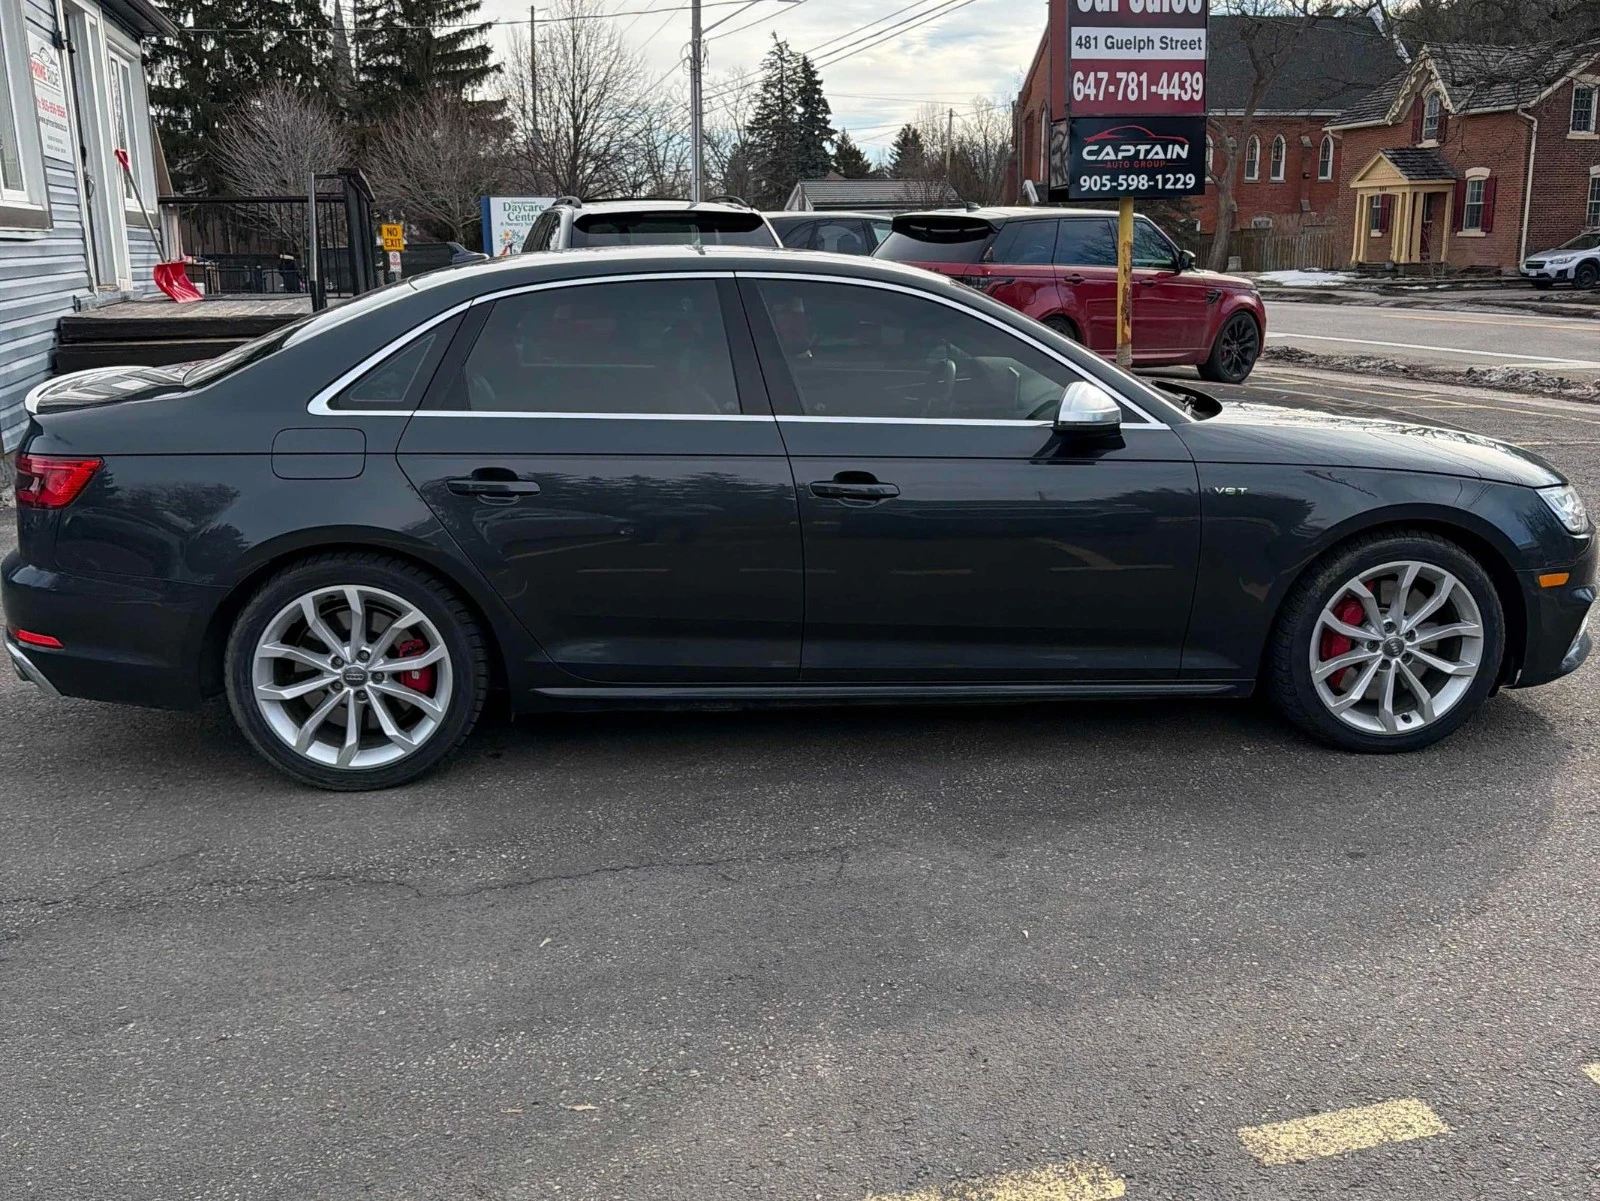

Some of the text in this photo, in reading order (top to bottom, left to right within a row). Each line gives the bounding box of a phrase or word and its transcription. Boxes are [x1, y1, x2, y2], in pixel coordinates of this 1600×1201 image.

[1075, 35, 1203, 53] 481 Guelph Street
[1073, 71, 1204, 101] 647-781-4439
[1082, 144, 1189, 160] CAPTAIN
[1080, 173, 1196, 191] 905-598-1229
[503, 202, 545, 213] Daycare
[507, 212, 538, 222] Centr
[386, 227, 398, 237] NO
[384, 238, 402, 248] EXIT
